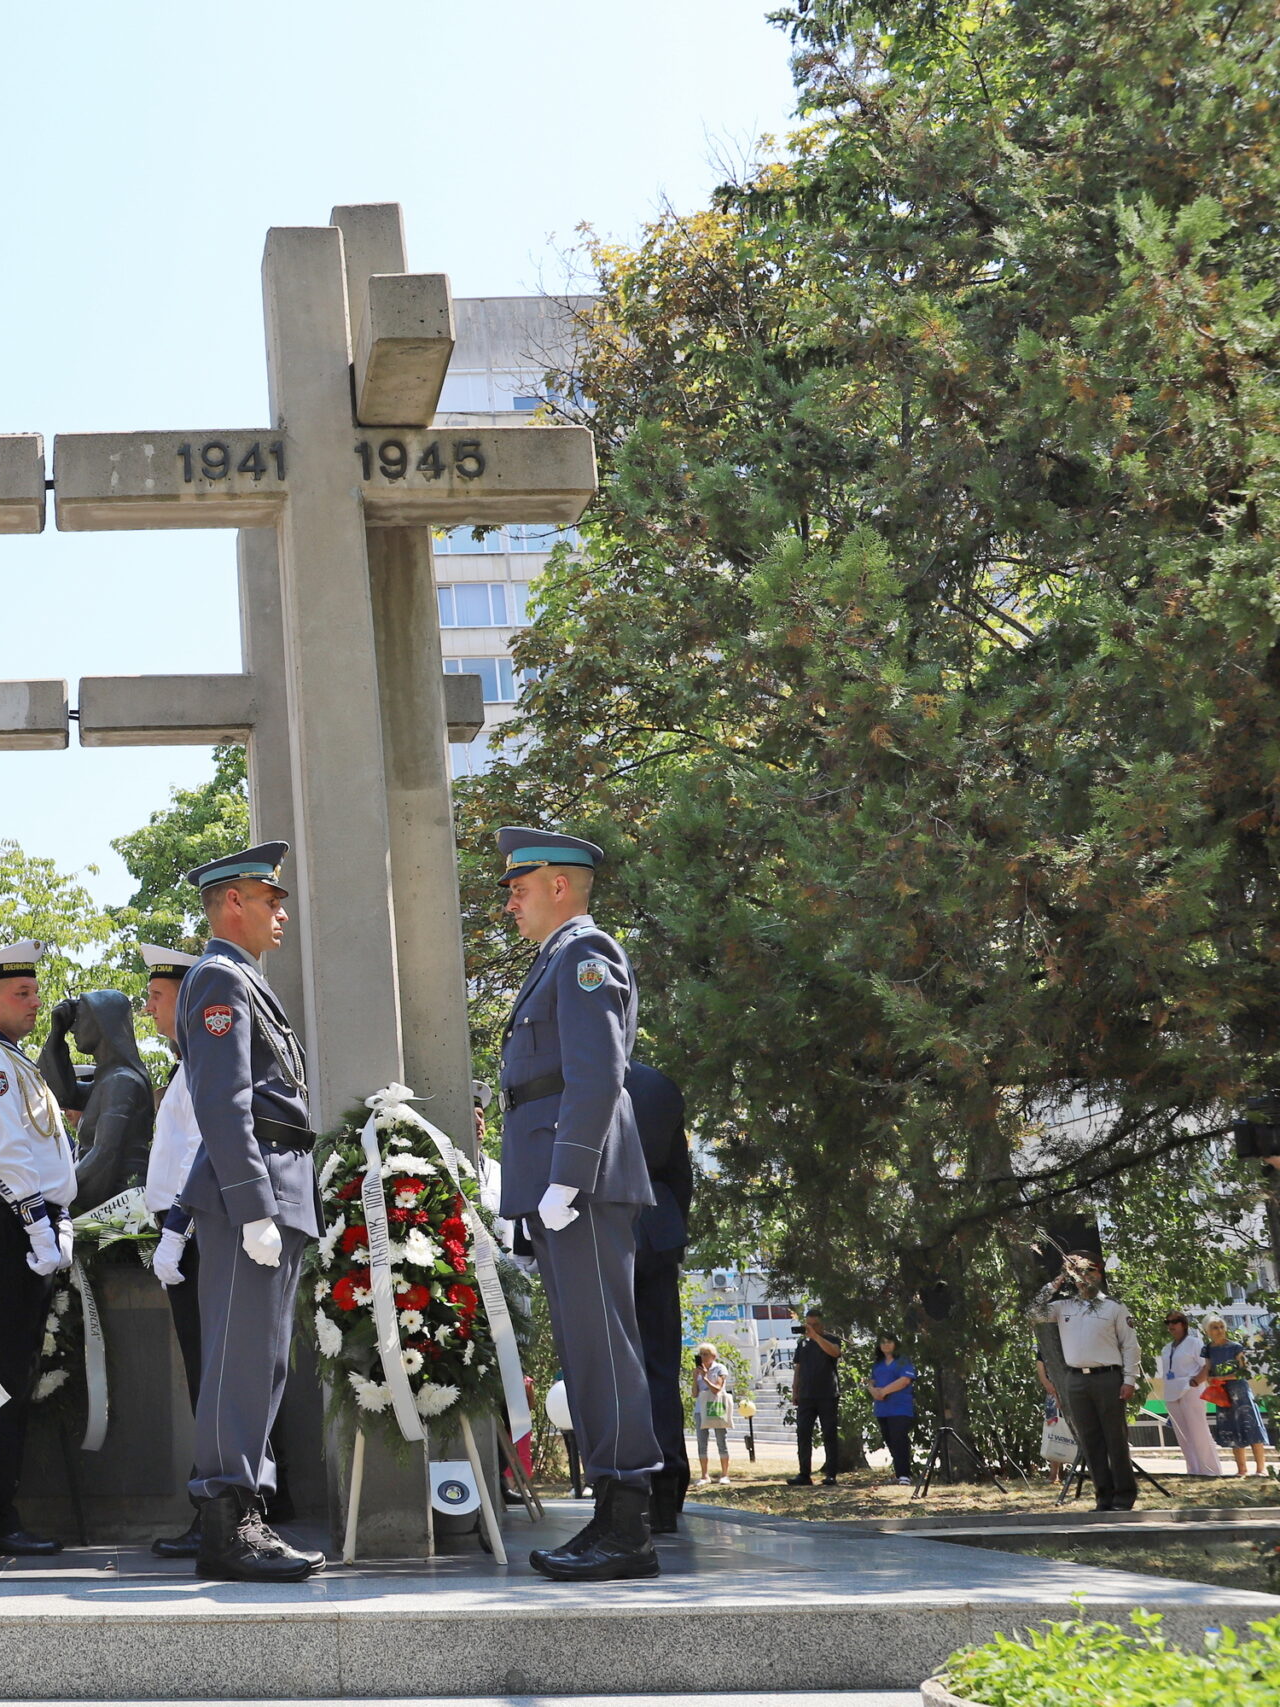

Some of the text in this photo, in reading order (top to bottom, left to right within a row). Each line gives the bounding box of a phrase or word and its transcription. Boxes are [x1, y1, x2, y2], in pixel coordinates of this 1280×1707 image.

[177, 440, 486, 483] 1941 1945
[368, 1216, 389, 1268] ДЪЛБОК
